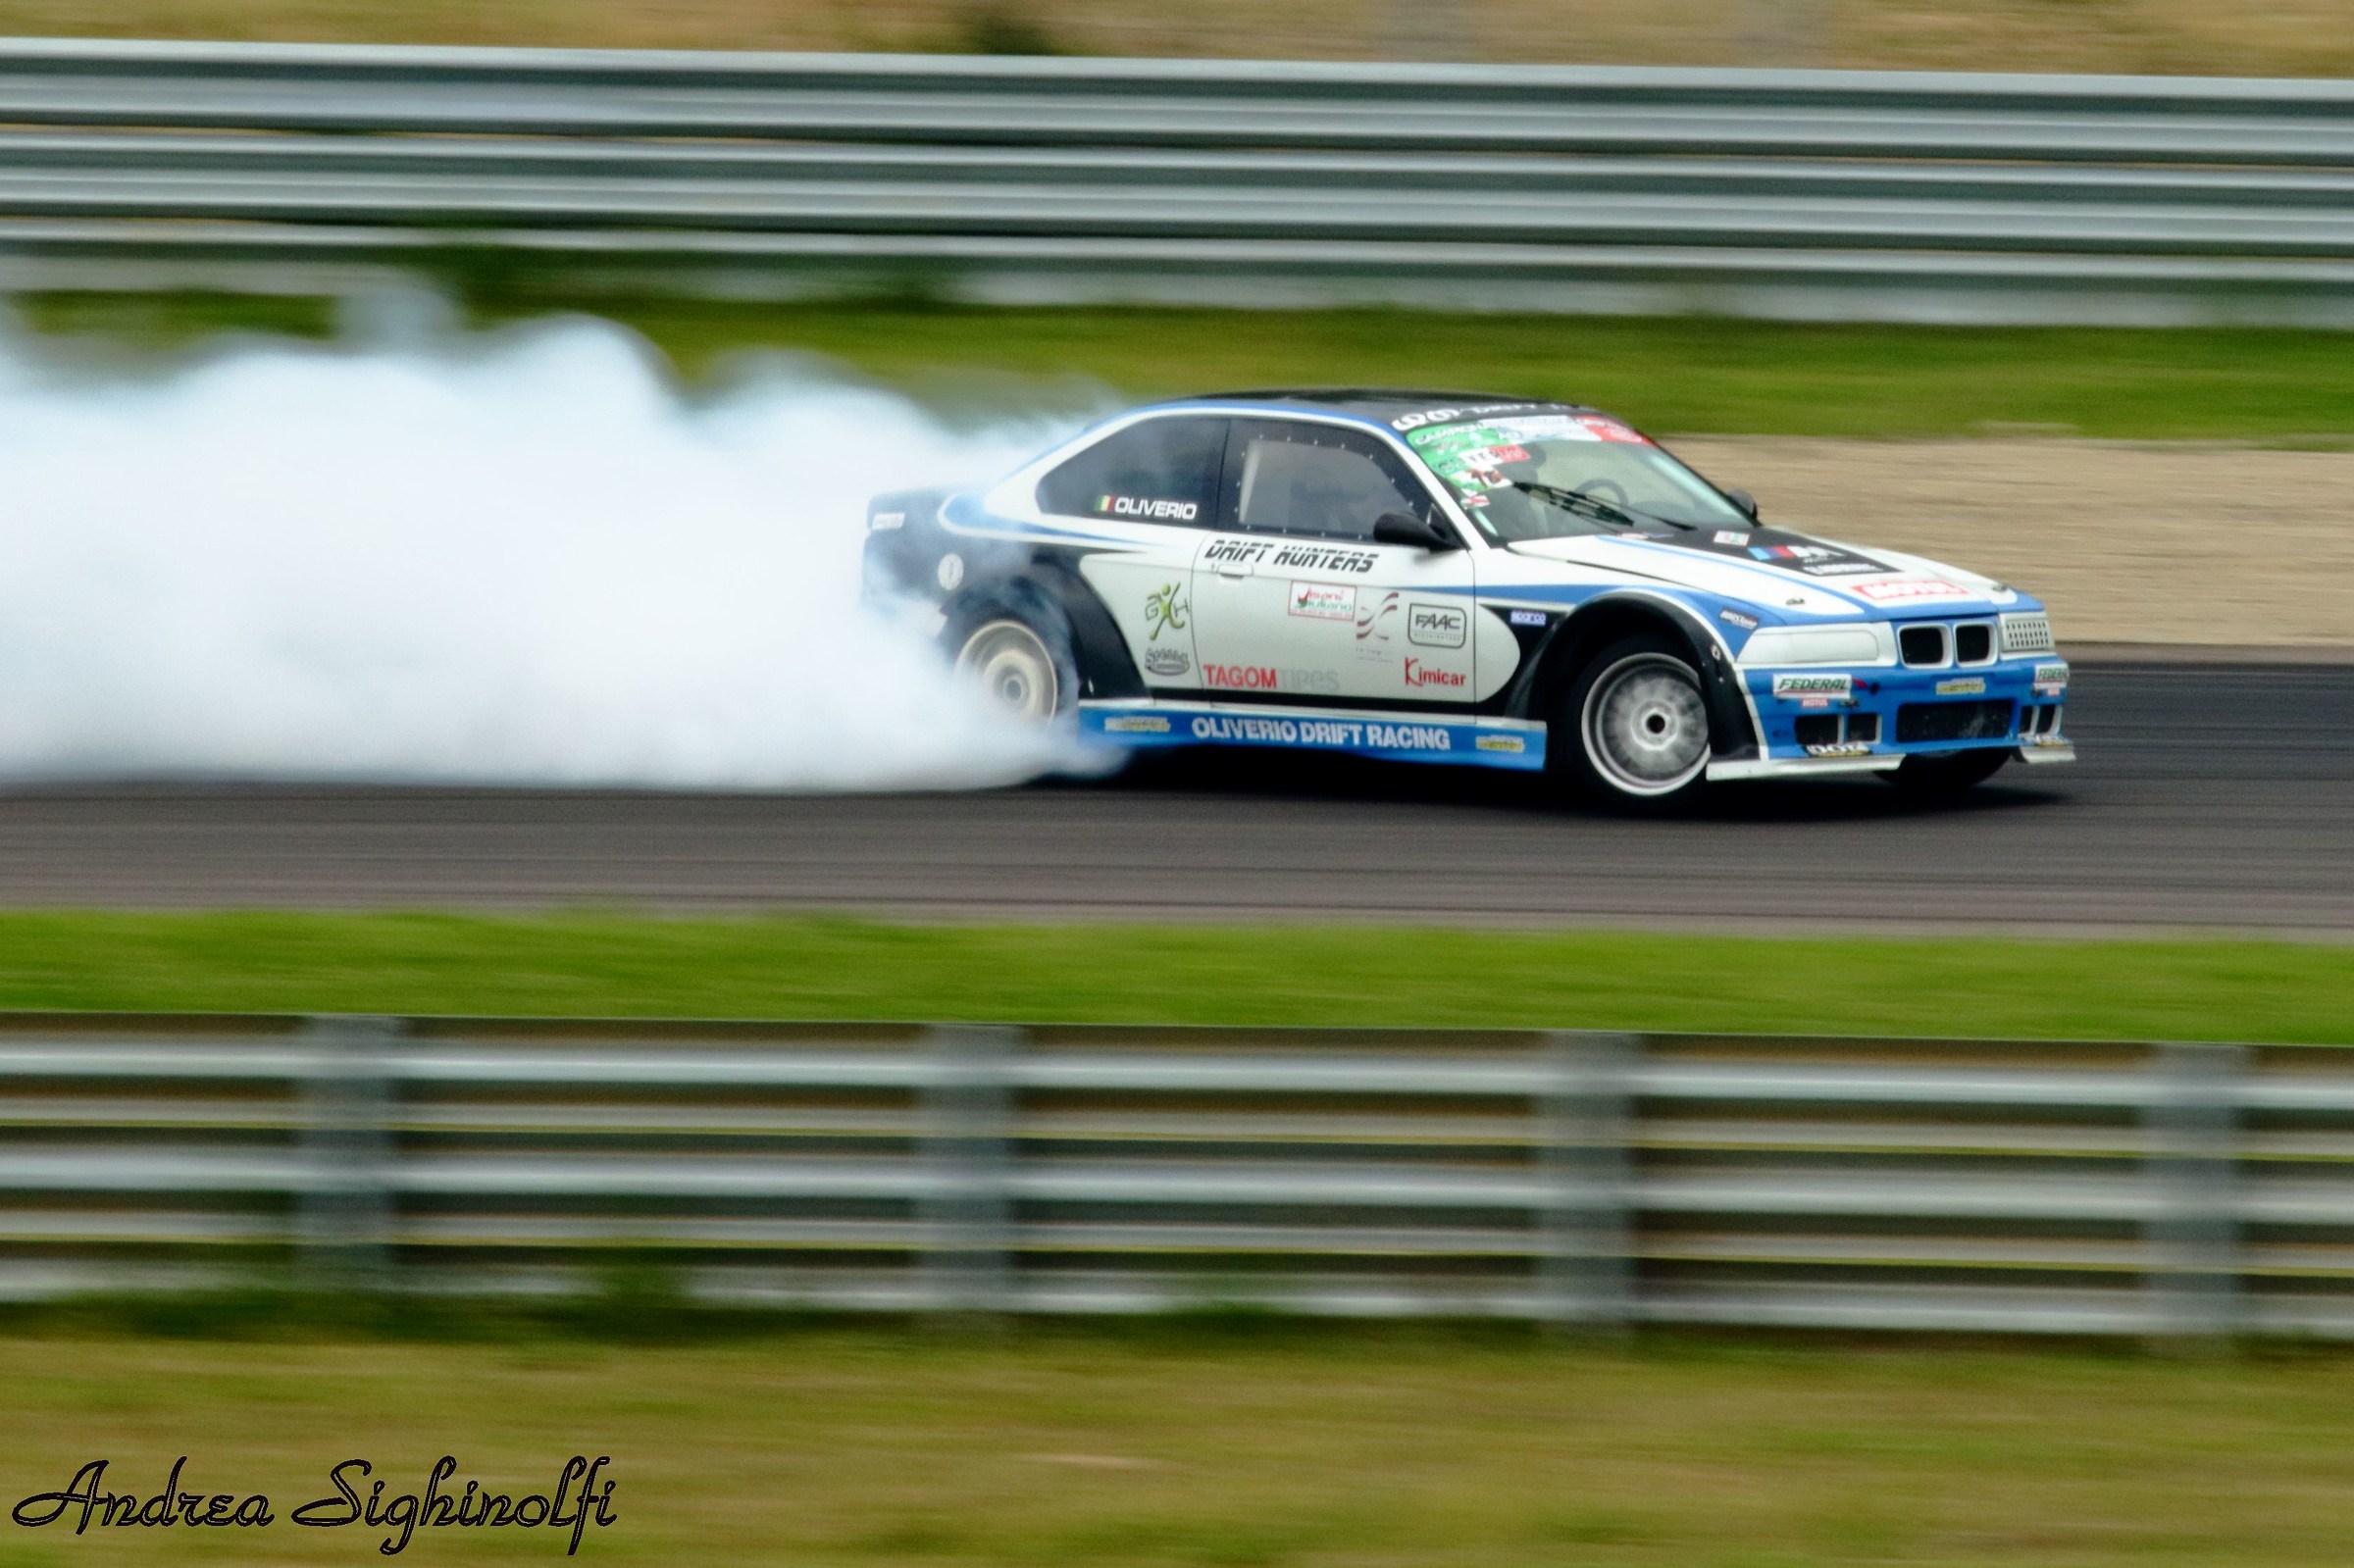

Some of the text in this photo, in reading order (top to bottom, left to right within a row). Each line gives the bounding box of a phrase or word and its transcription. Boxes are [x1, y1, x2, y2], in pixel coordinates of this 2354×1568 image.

[1114, 497, 1197, 520] OLIVERIO
[1204, 539, 1379, 574] DRIFT HUNTERS
[1415, 614, 1460, 631] FAAC
[1203, 664, 1277, 688] TAGOM
[1405, 657, 1466, 686] Kimicar
[1778, 678, 1848, 690] FEDERAL
[1192, 716, 1297, 742] OLIVERIO
[1300, 722, 1363, 747] DRIFT
[1366, 725, 1451, 750] RACING
